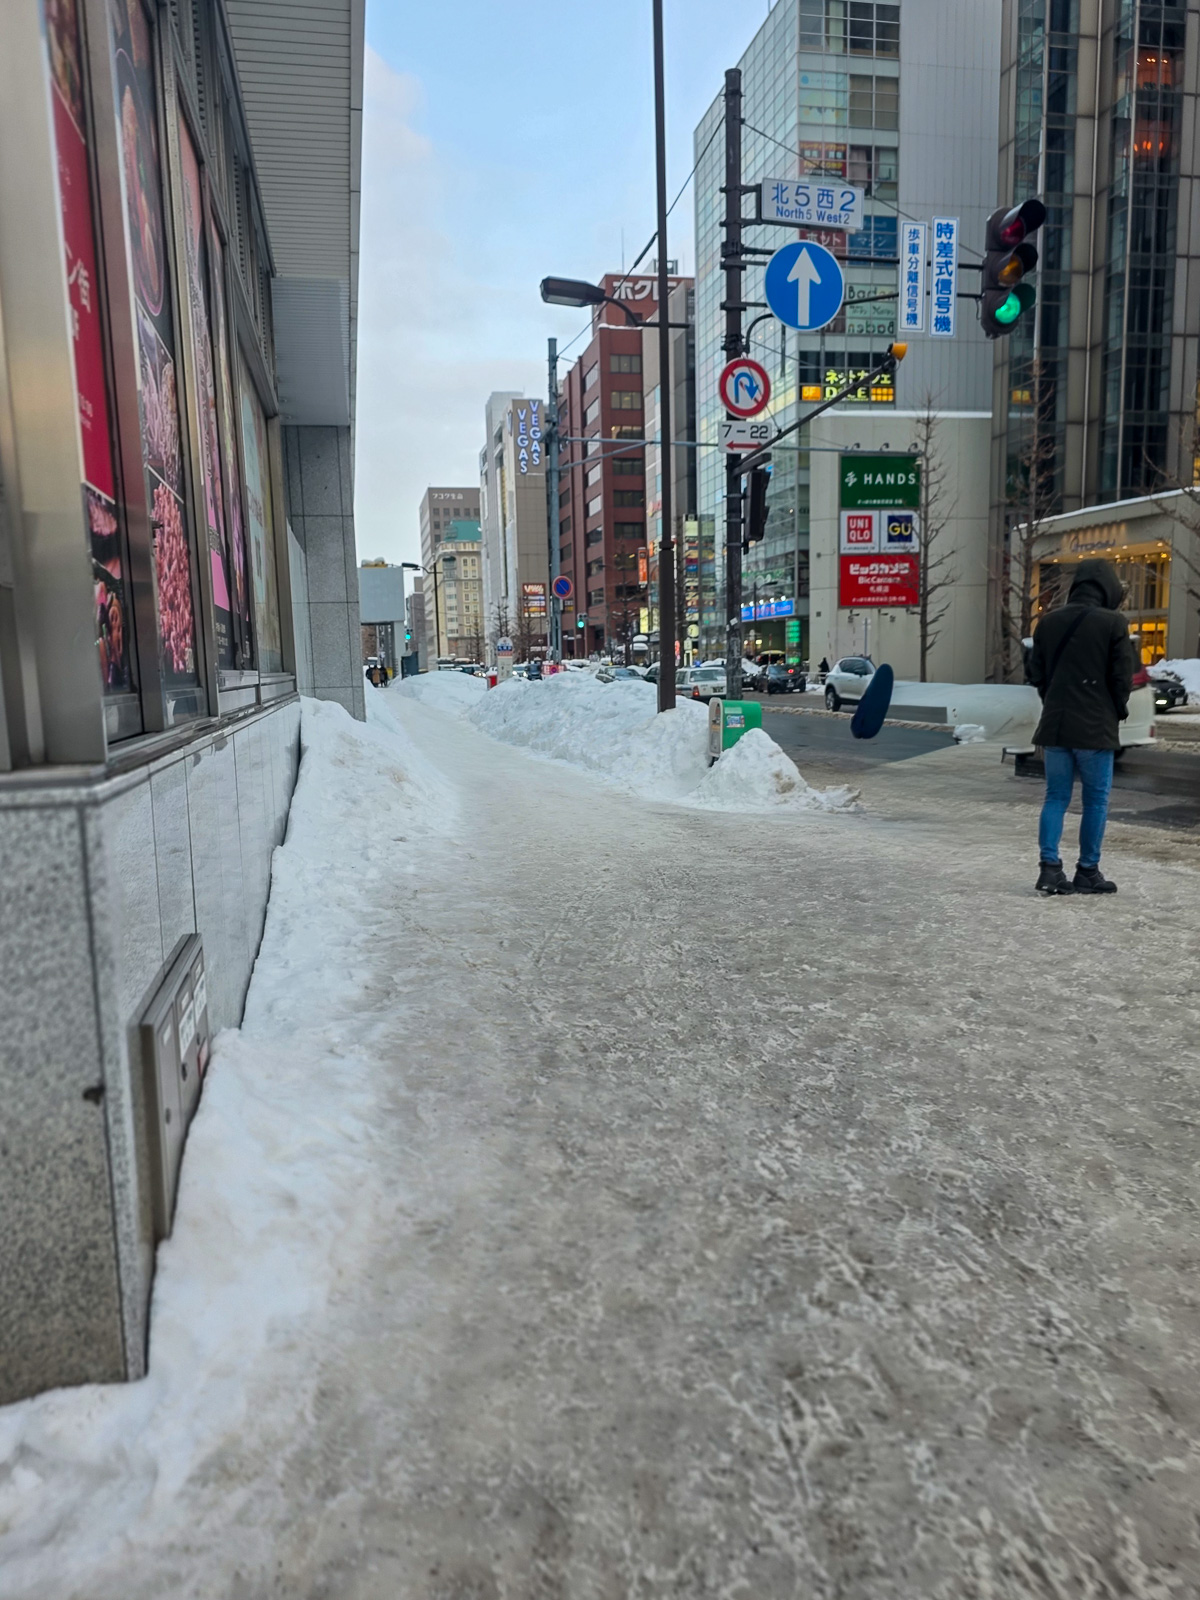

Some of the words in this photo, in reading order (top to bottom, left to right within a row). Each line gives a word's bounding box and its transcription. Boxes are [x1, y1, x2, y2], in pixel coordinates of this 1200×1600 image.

[906, 228, 920, 326] 歩車分離信号機
[934, 222, 954, 332] 時差式信号機
[825, 386, 867, 398] DE
[529, 400, 541, 465] VEGAS
[517, 408, 529, 473] VEGAS
[864, 473, 916, 485] HANDS
[849, 518, 869, 529] UNI
[888, 522, 911, 536] GU
[849, 530, 870, 542] QLO
[849, 563, 910, 575] ビックカメラ
